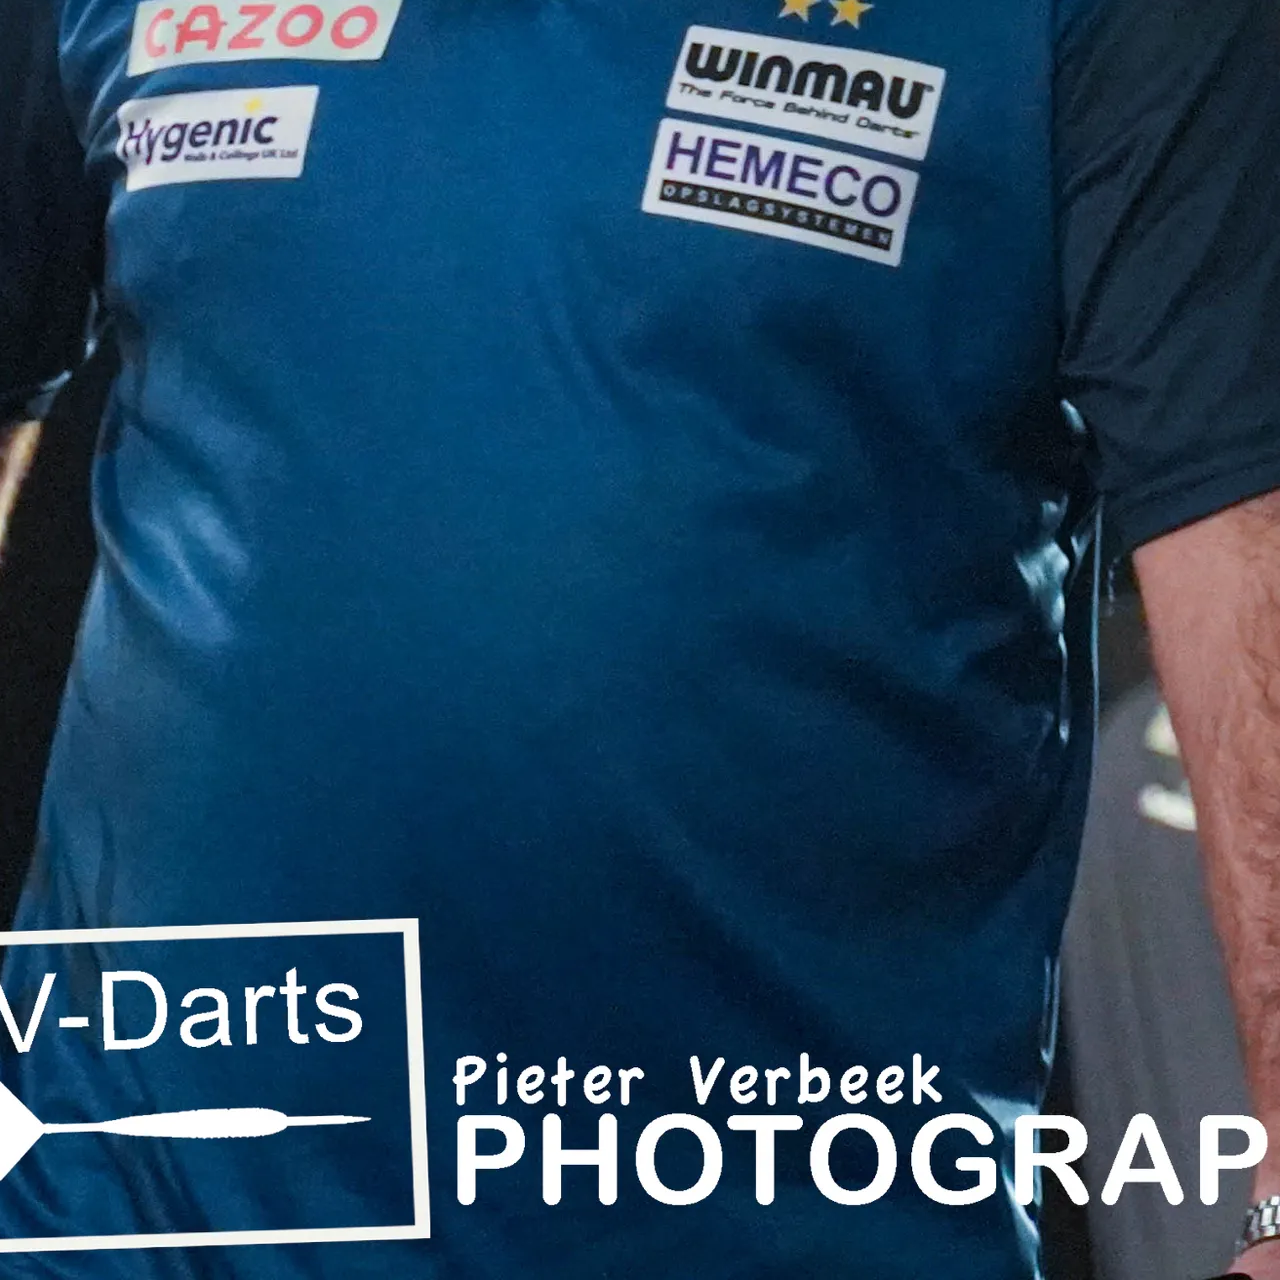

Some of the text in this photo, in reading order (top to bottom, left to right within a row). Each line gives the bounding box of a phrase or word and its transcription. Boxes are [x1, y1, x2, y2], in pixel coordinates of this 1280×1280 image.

[144, 4, 379, 58] CAZOO
[679, 82, 914, 138] The Force Behind Darts
[685, 42, 926, 119] WINMAU
[122, 115, 280, 166] Hygenic
[666, 131, 902, 218] HEMECO
[662, 184, 892, 246] OPSLAGSYSTEMEN
